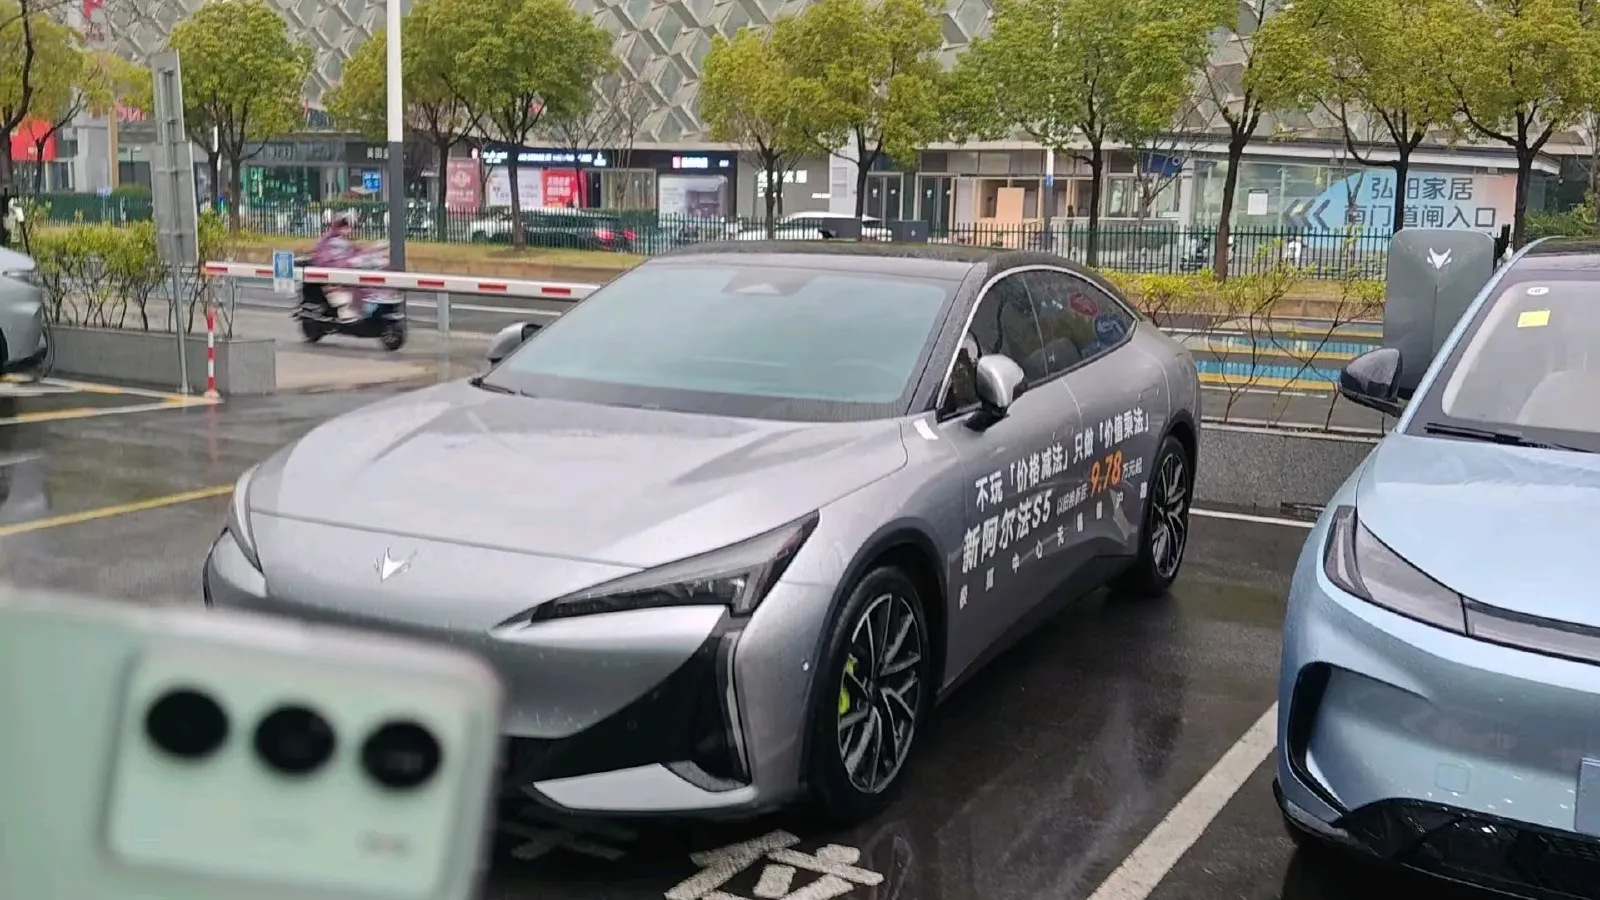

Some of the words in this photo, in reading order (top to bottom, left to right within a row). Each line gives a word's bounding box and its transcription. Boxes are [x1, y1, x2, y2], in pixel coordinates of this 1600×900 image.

[962, 488, 1053, 573] 新阿尔法S5
[1091, 450, 1123, 498] 9.78
